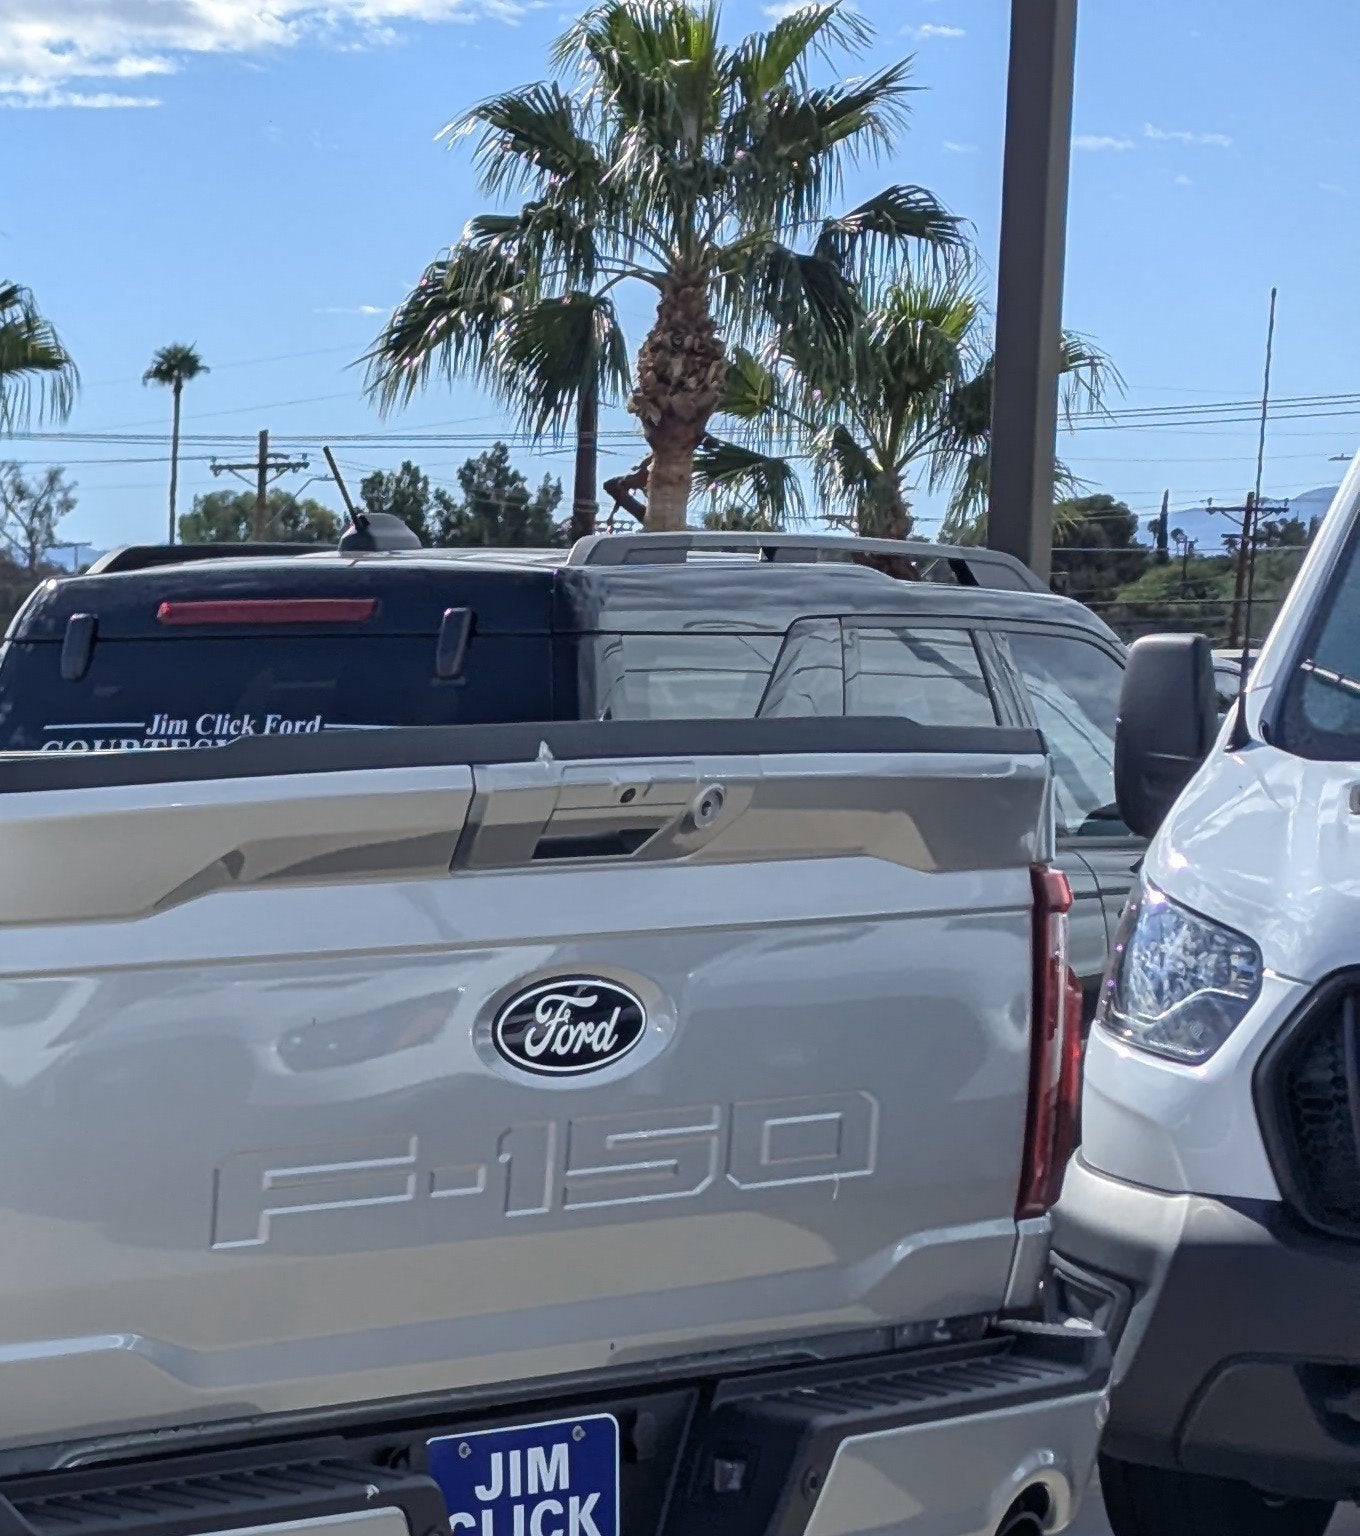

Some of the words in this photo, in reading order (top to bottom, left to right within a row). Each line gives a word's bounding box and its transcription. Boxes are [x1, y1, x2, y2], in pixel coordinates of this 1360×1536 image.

[145, 713, 188, 736] Jim
[194, 713, 256, 736] Click
[263, 714, 323, 736] Ford
[524, 993, 622, 1058] Ford
[210, 1090, 878, 1250] F-150
[474, 1442, 570, 1501] JIM
